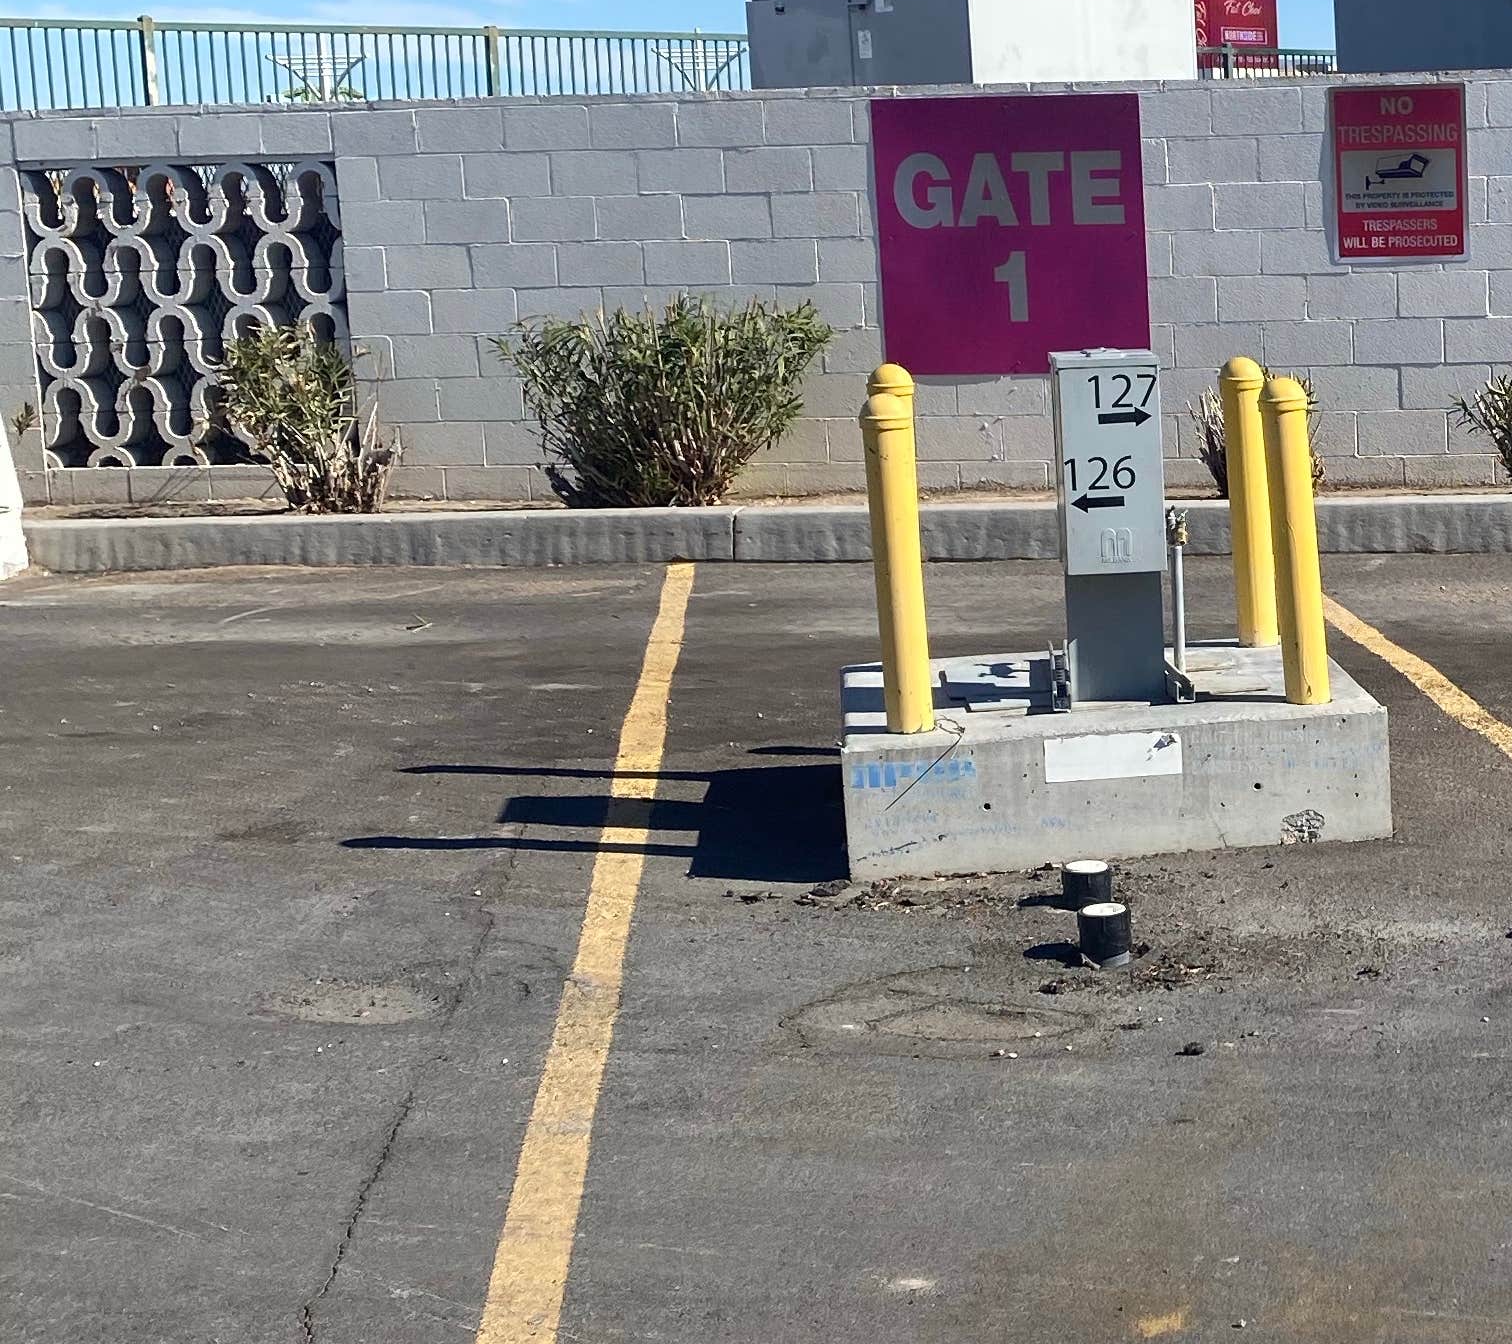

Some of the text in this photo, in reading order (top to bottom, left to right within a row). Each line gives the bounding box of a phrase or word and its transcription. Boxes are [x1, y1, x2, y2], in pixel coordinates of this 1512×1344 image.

[1223, 0, 1241, 15] Fat
[1380, 96, 1414, 115] NO
[1338, 123, 1459, 144] TRESPASSING
[893, 150, 1126, 230] GATE
[1363, 192, 1400, 200] PROPERTY
[1410, 191, 1454, 199] PROTECTED
[1362, 218, 1438, 232] TRESPASSERS
[1343, 235, 1458, 249] WILL BE PROSECUTED
[993, 250, 1029, 322] 1
[1087, 374, 1157, 409] 127
[1064, 455, 1136, 491] 126
